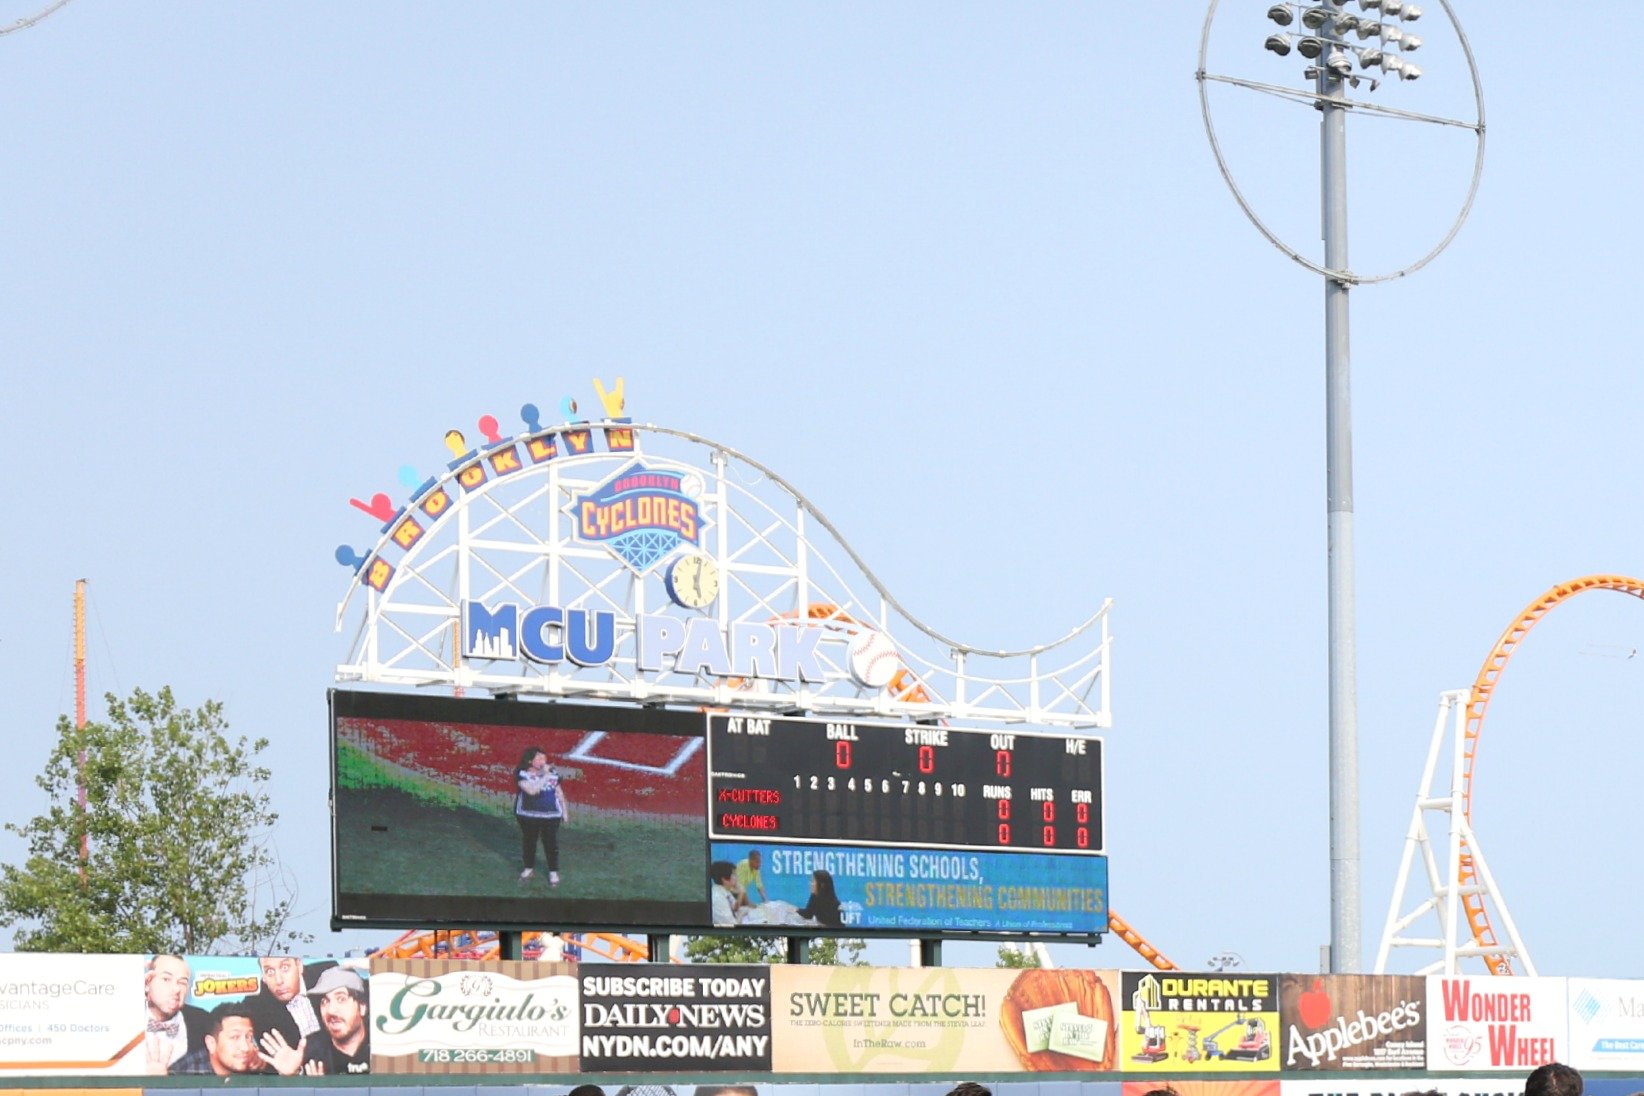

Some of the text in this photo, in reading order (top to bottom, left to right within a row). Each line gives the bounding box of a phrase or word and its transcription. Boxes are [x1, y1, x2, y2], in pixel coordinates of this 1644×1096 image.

[581, 496, 696, 541] CYCLONES
[464, 600, 828, 683] MCU PARK
[727, 717, 771, 736] AT BAT
[826, 723, 859, 741] BALL
[905, 729, 949, 747] STRIKE
[990, 734, 1015, 750] OUT
[1065, 739, 1087, 755] H/E
[836, 741, 851, 769] 0
[918, 745, 934, 774] 0
[793, 774, 966, 797] 1 2 3 4 5 6 7 8 9 10
[983, 785, 1012, 800] RUNS
[1030, 788, 1054, 802] HITS
[1071, 790, 1092, 804] ERR
[998, 799, 1088, 823] 0 0 0
[722, 814, 777, 830] CYCLONES
[998, 823, 1088, 847] 0 0 0
[772, 849, 984, 885] STRENGTHENING SCHOOLS,
[865, 882, 1104, 913] STRENGTHENING COMMUNITIES
[840, 911, 861, 924] UFT
[194, 976, 259, 997] JOKERS
[583, 977, 766, 998] SUBSCRIBE TODAY
[1162, 978, 1269, 997] DURANTE
[376, 974, 572, 1032] Gargiulo's
[790, 992, 987, 1018] SWEET CATCH!
[1168, 998, 1262, 1012] RENTALS
[1441, 979, 1531, 1022] WONDER
[584, 1004, 765, 1028] DAILY NEWS
[47, 1024, 67, 1033] 450
[478, 1021, 569, 1039] RESTAURANT
[1287, 1001, 1421, 1067] Applebee's
[582, 1036, 769, 1059] NYDN.COM/ANY
[853, 1038, 927, 1049] InTheRaw.com
[422, 1049, 533, 1063] 718 266-4891
